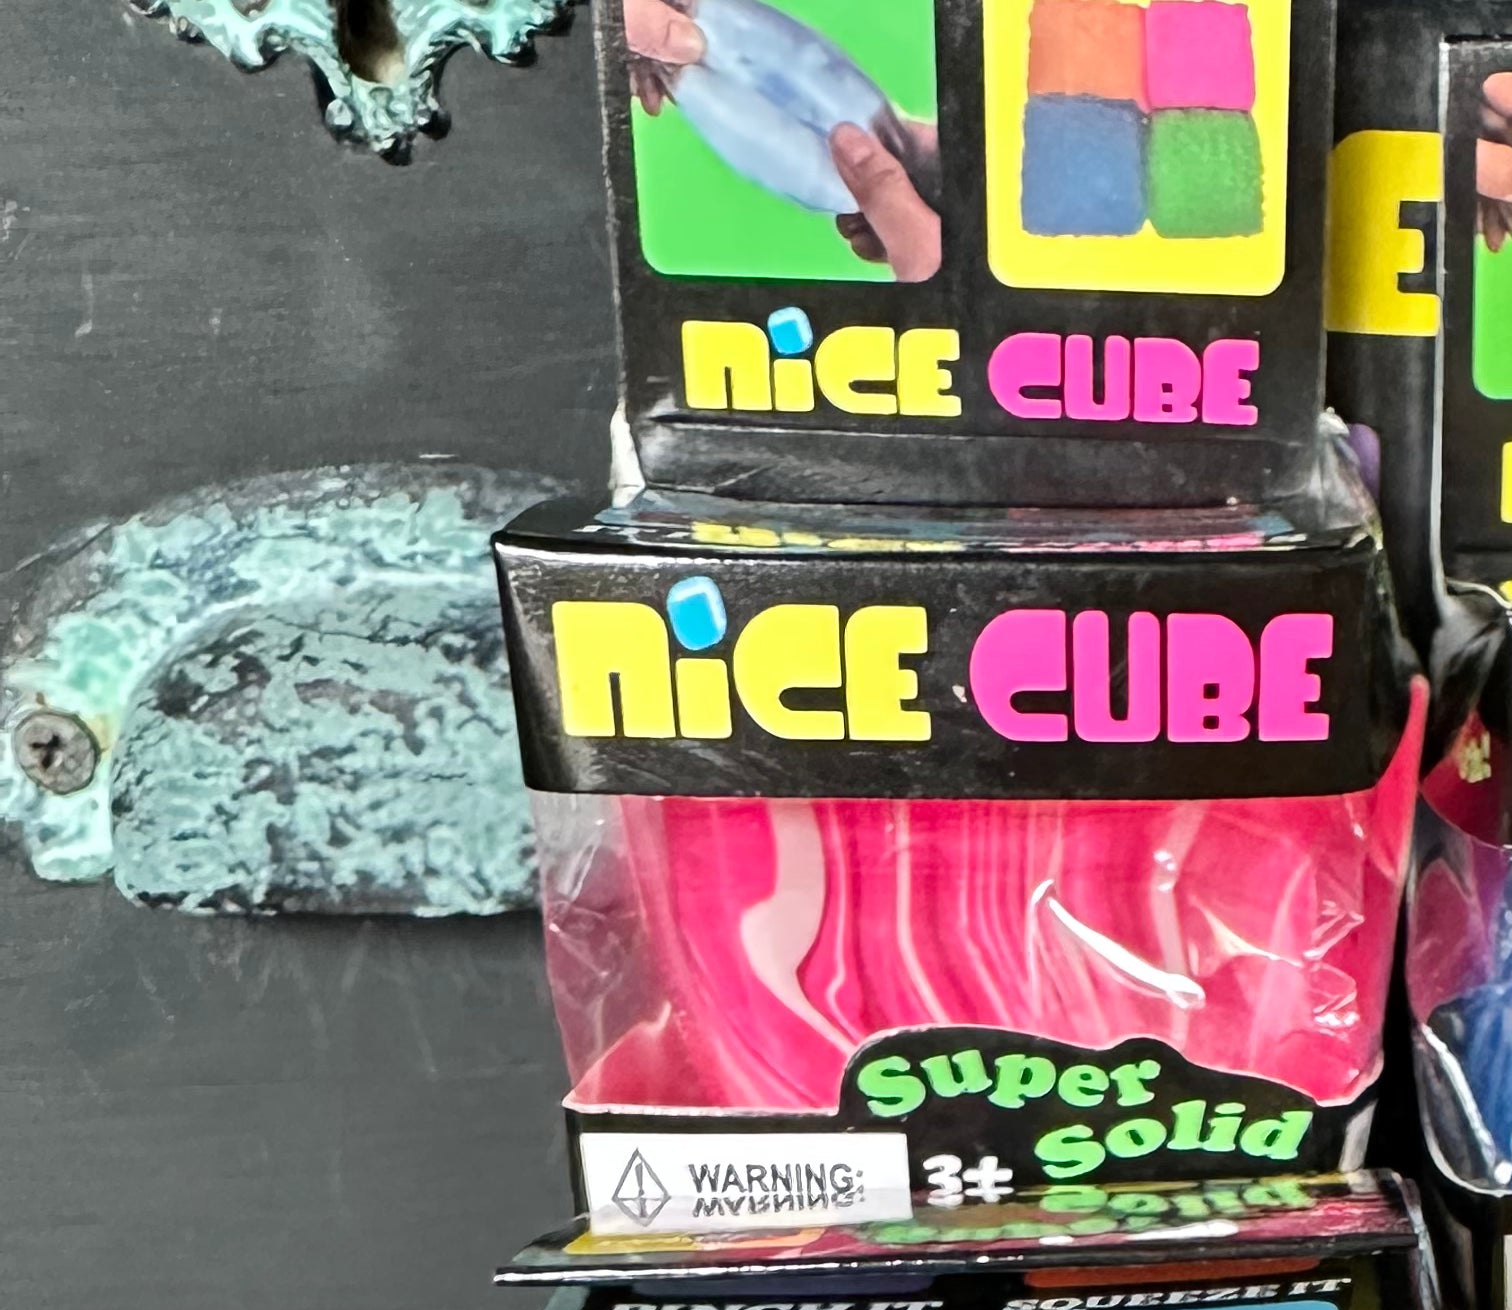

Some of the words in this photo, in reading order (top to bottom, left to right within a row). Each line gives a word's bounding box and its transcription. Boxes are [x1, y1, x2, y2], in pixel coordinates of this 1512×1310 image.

[987, 332, 1261, 426] CUBE
[969, 608, 1335, 742] CUBE
[857, 1049, 1161, 1118] Super
[1034, 1099, 1314, 1180] Solid
[688, 1162, 865, 1195] WARNING:
[1287, 1277, 1352, 1297] IT
